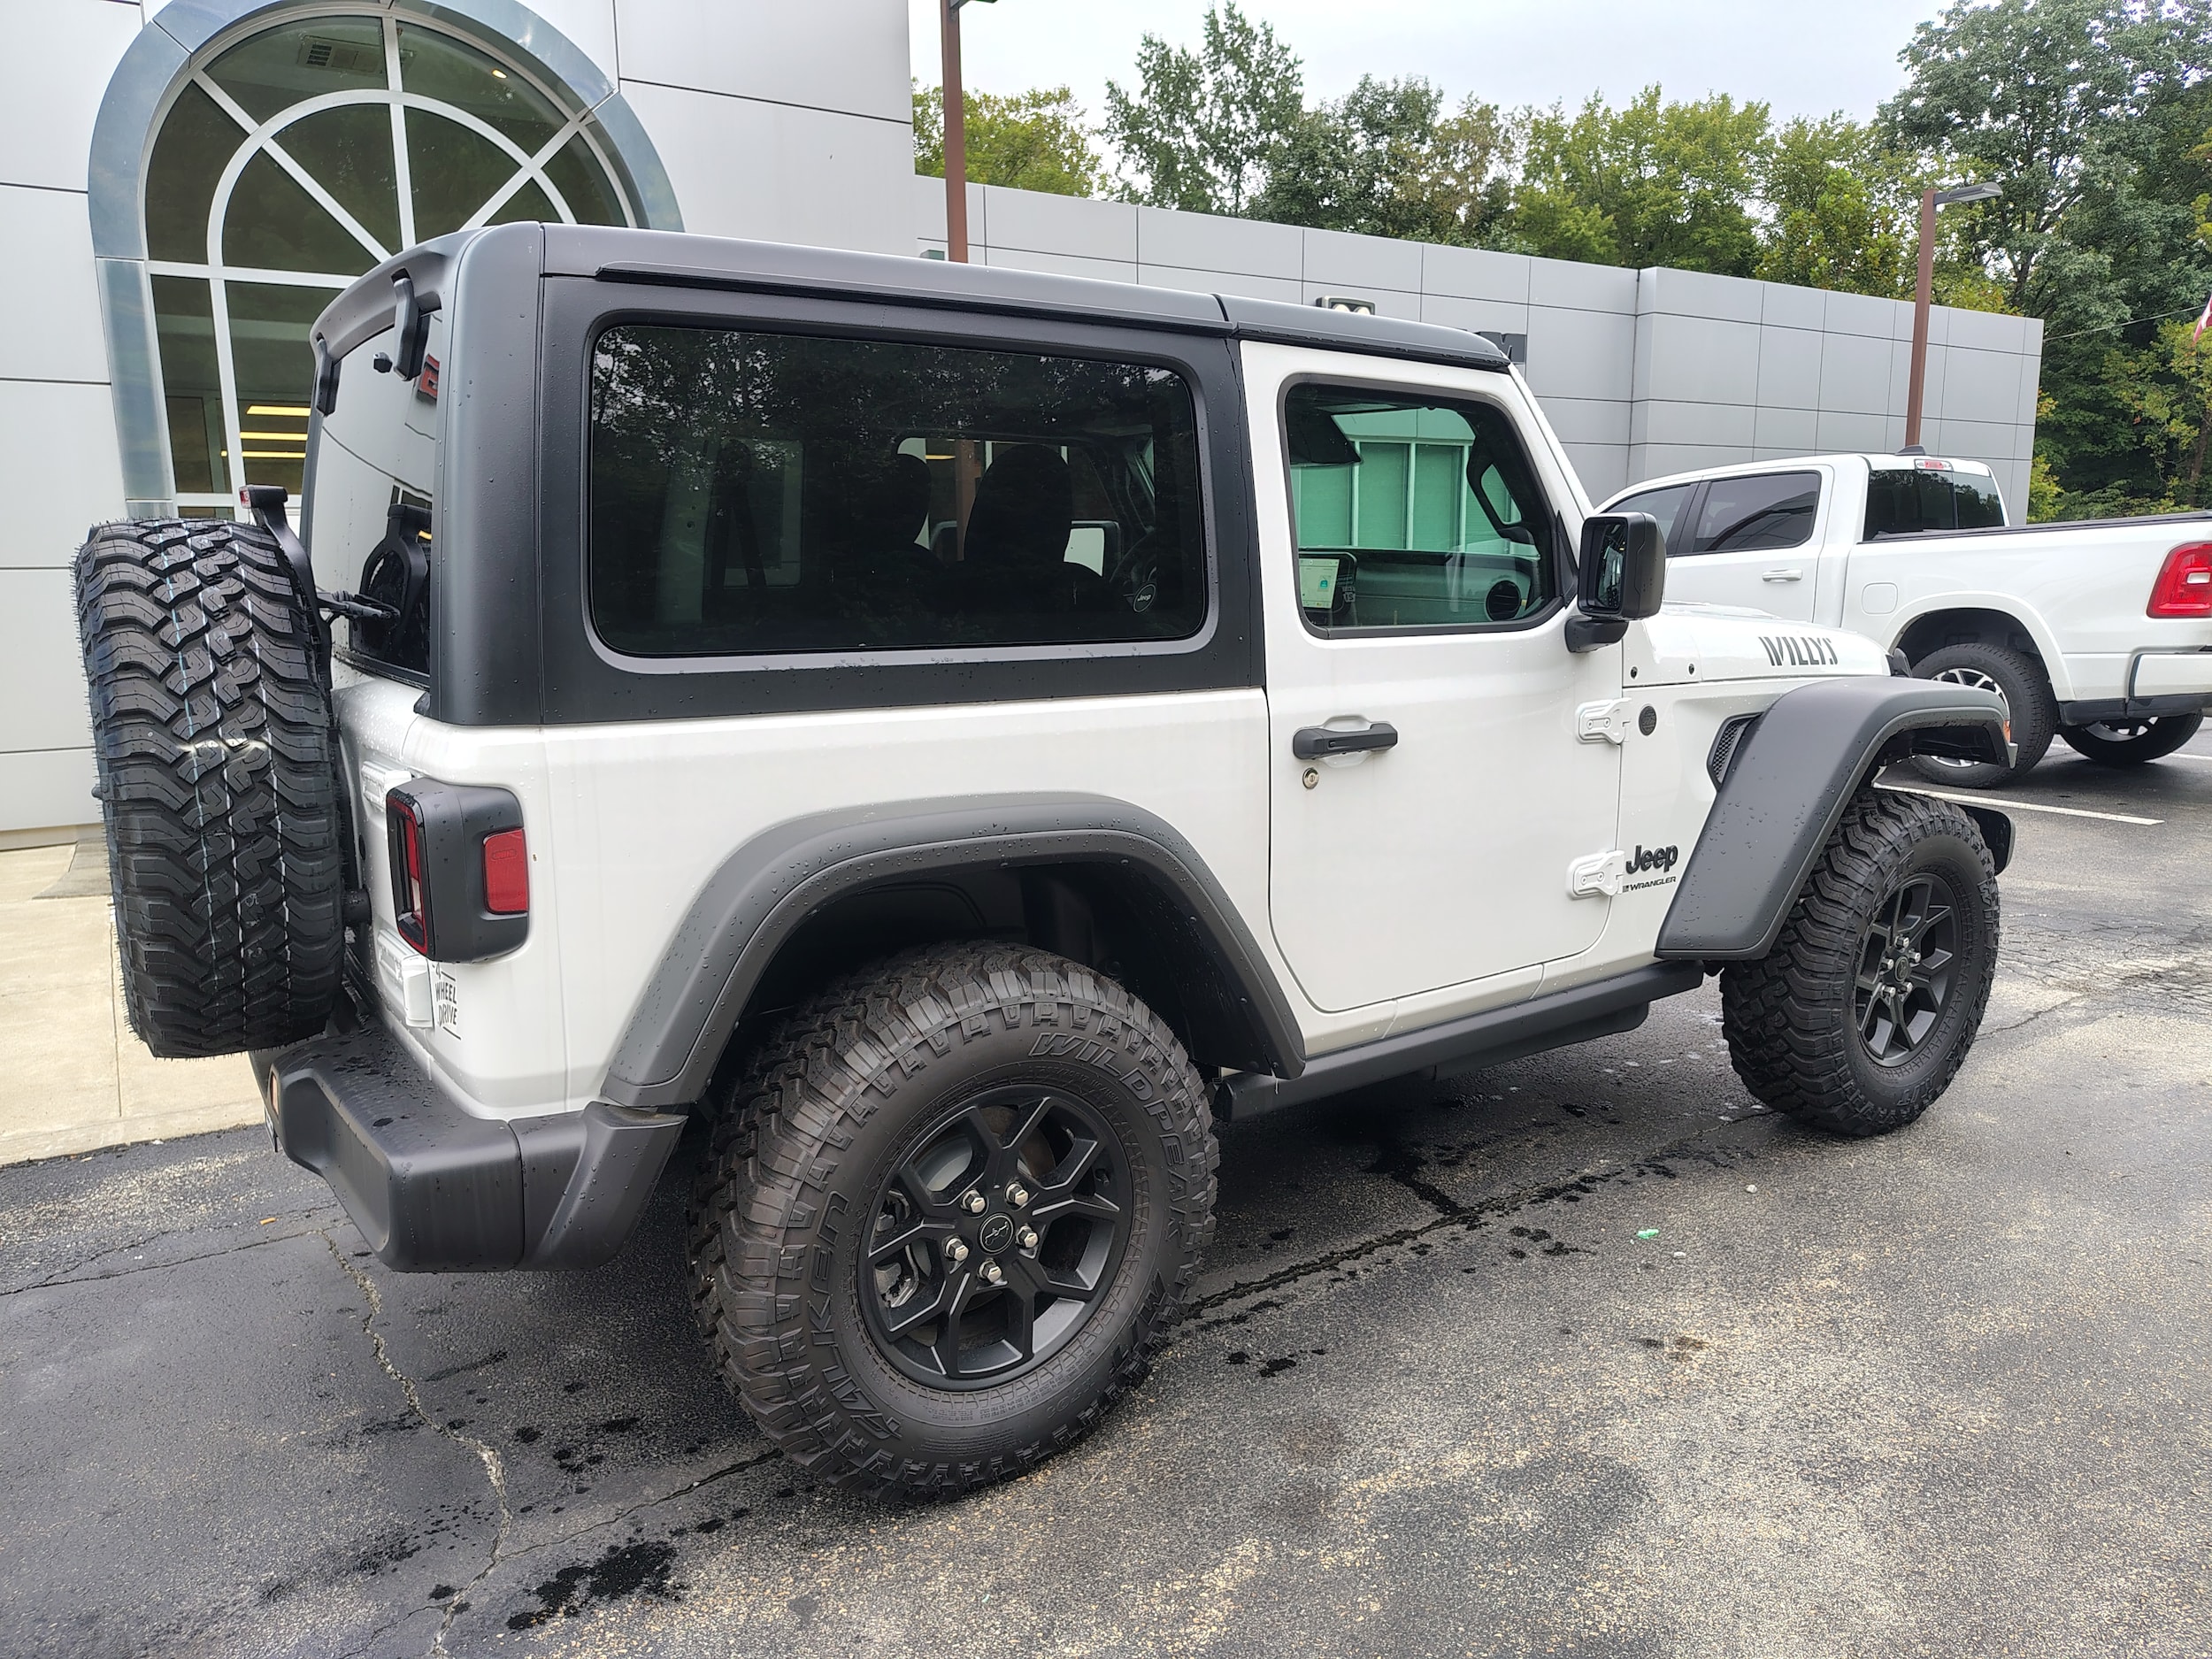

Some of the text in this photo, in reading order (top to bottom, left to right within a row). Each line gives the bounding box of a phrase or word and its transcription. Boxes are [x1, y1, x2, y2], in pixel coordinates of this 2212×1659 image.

[1757, 636, 1839, 667] WILLYS
[1625, 844, 1678, 874] Jeep
[1630, 876, 1677, 891] WRANGLER
[435, 981, 457, 1004] WHEEL
[438, 1002, 457, 1026] DRIVE
[1029, 1032, 1188, 1243] WILDPEAK
